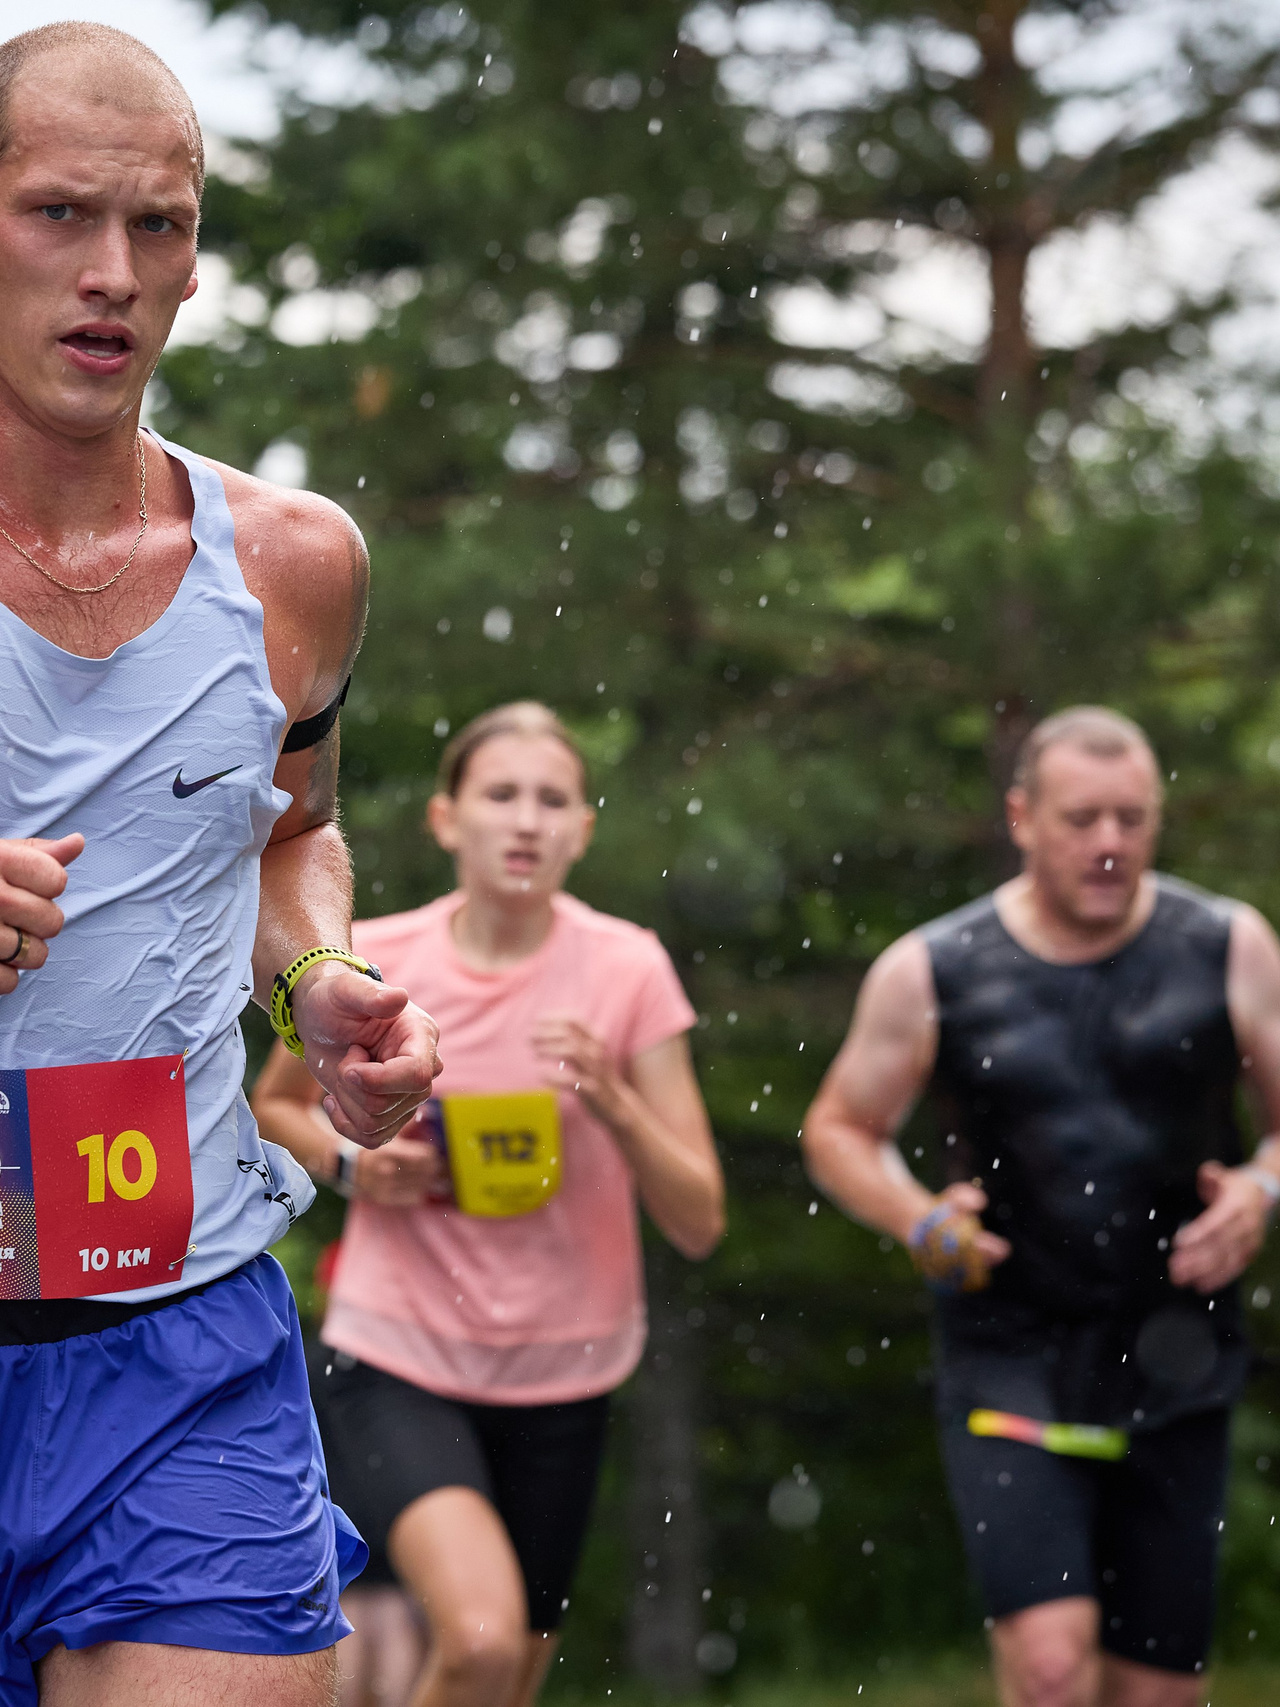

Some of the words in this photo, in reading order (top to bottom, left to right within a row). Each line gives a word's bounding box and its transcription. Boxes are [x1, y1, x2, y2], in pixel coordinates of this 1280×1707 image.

[478, 1129, 536, 1165] 112
[76, 1129, 158, 1204] 10
[78, 1247, 109, 1272] 10
